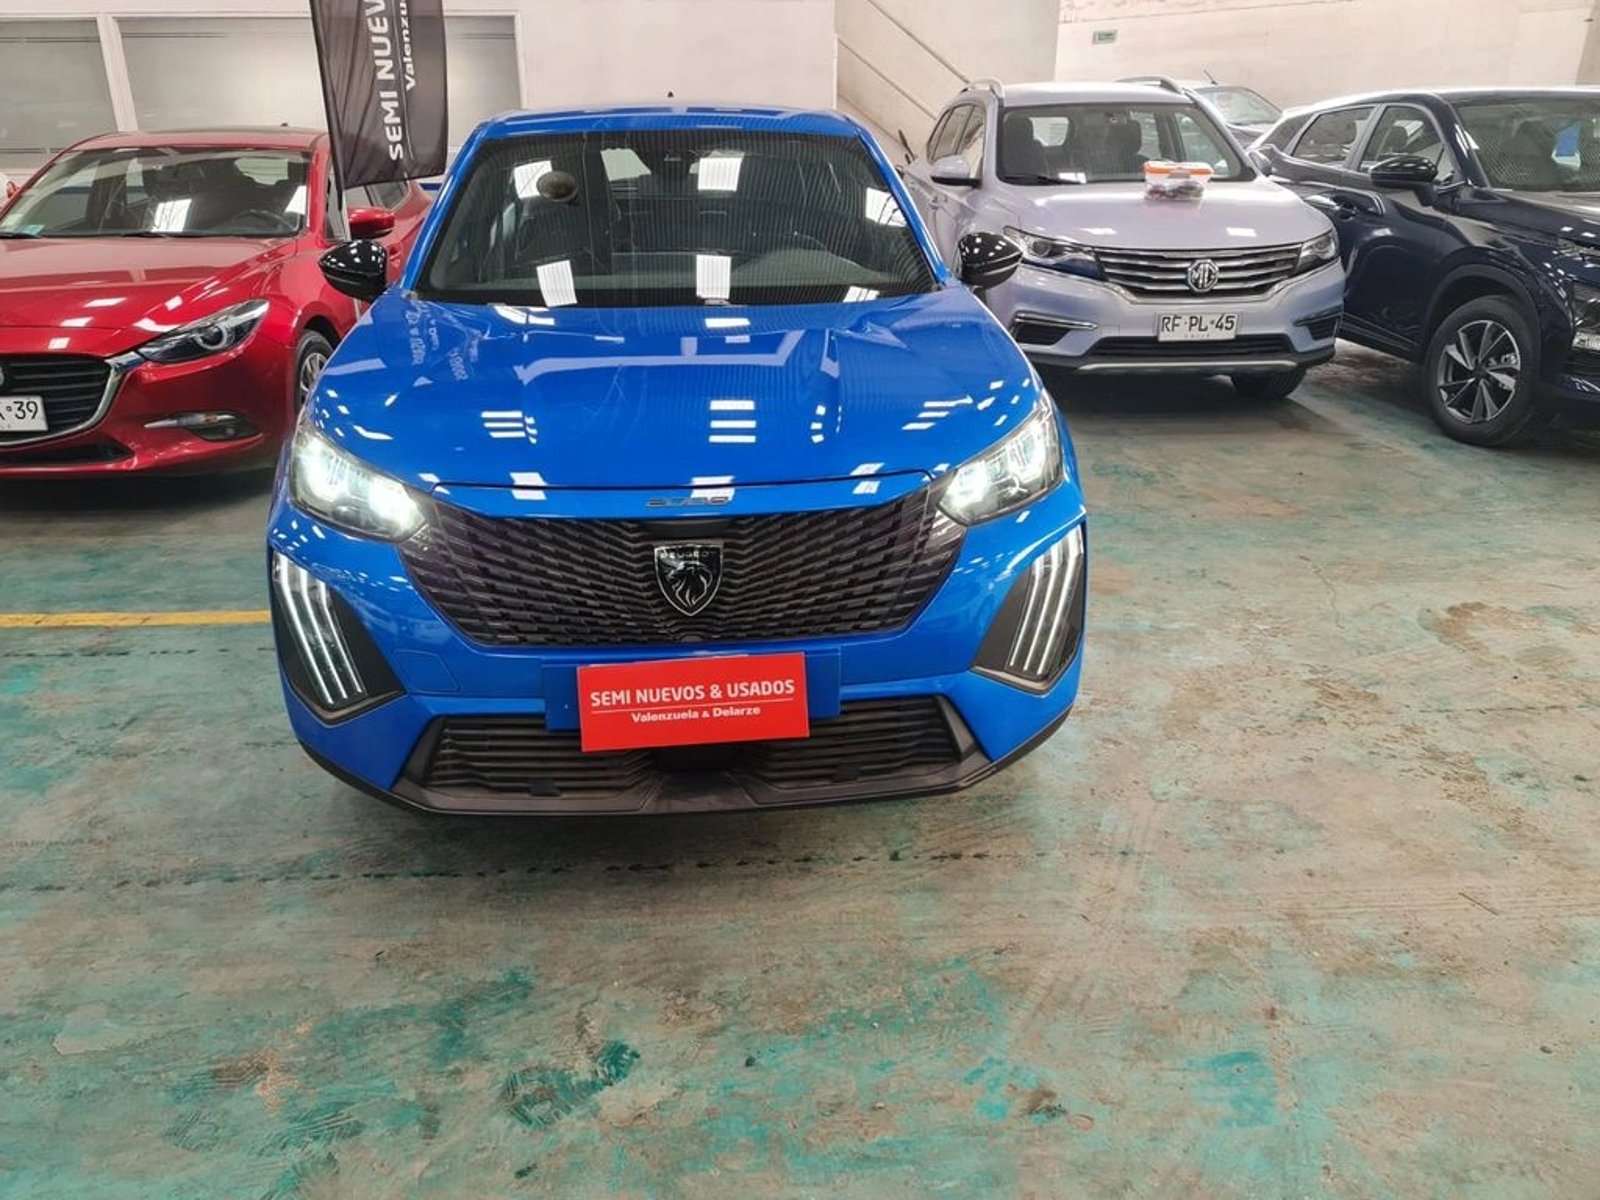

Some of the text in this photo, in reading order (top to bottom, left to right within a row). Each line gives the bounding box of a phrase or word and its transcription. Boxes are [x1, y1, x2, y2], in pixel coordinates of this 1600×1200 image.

[399, 0, 416, 91] Valenzu
[379, 90, 404, 161] SEMI
[1190, 261, 1217, 290] MG
[590, 679, 796, 708] SEMI NUEVOS & USADOS
[630, 705, 761, 724] Valenzuela & Delarze
